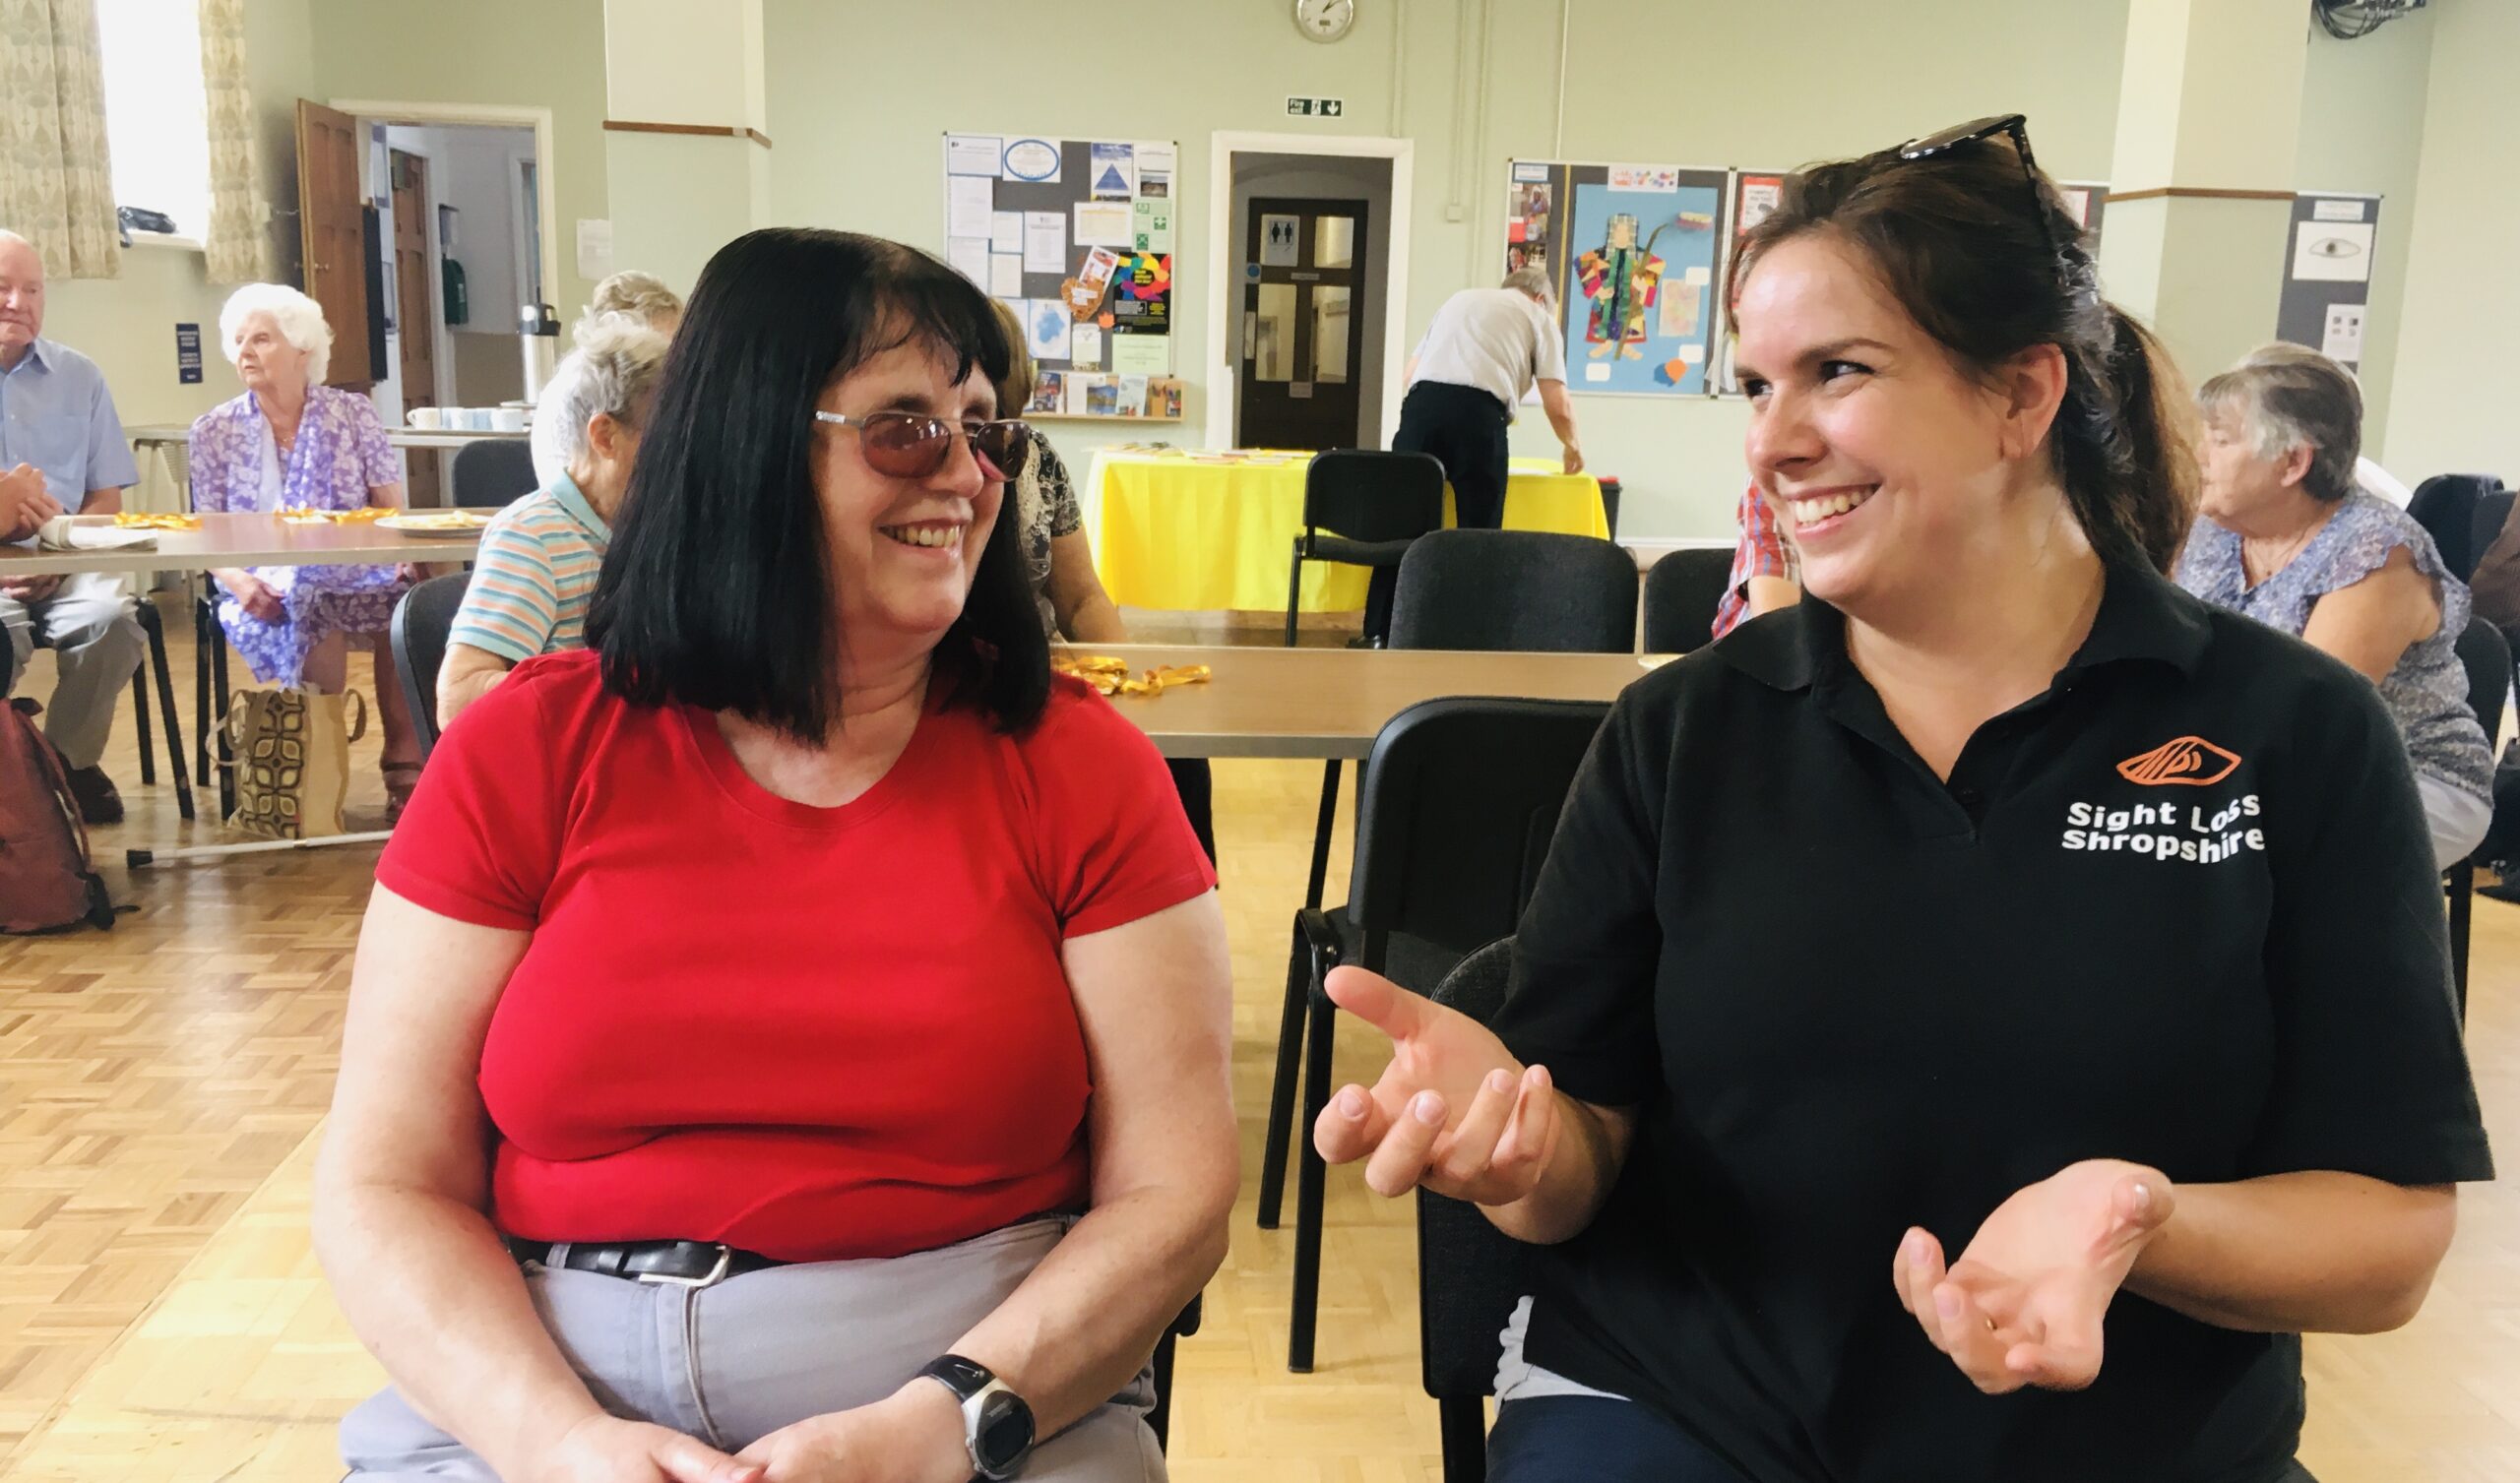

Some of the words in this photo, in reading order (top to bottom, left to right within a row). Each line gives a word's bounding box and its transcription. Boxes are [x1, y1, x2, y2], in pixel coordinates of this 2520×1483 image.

[2067, 802, 2177, 833] Sight
[2190, 794, 2260, 834] Loss
[2061, 829, 2265, 864] Shropshire
